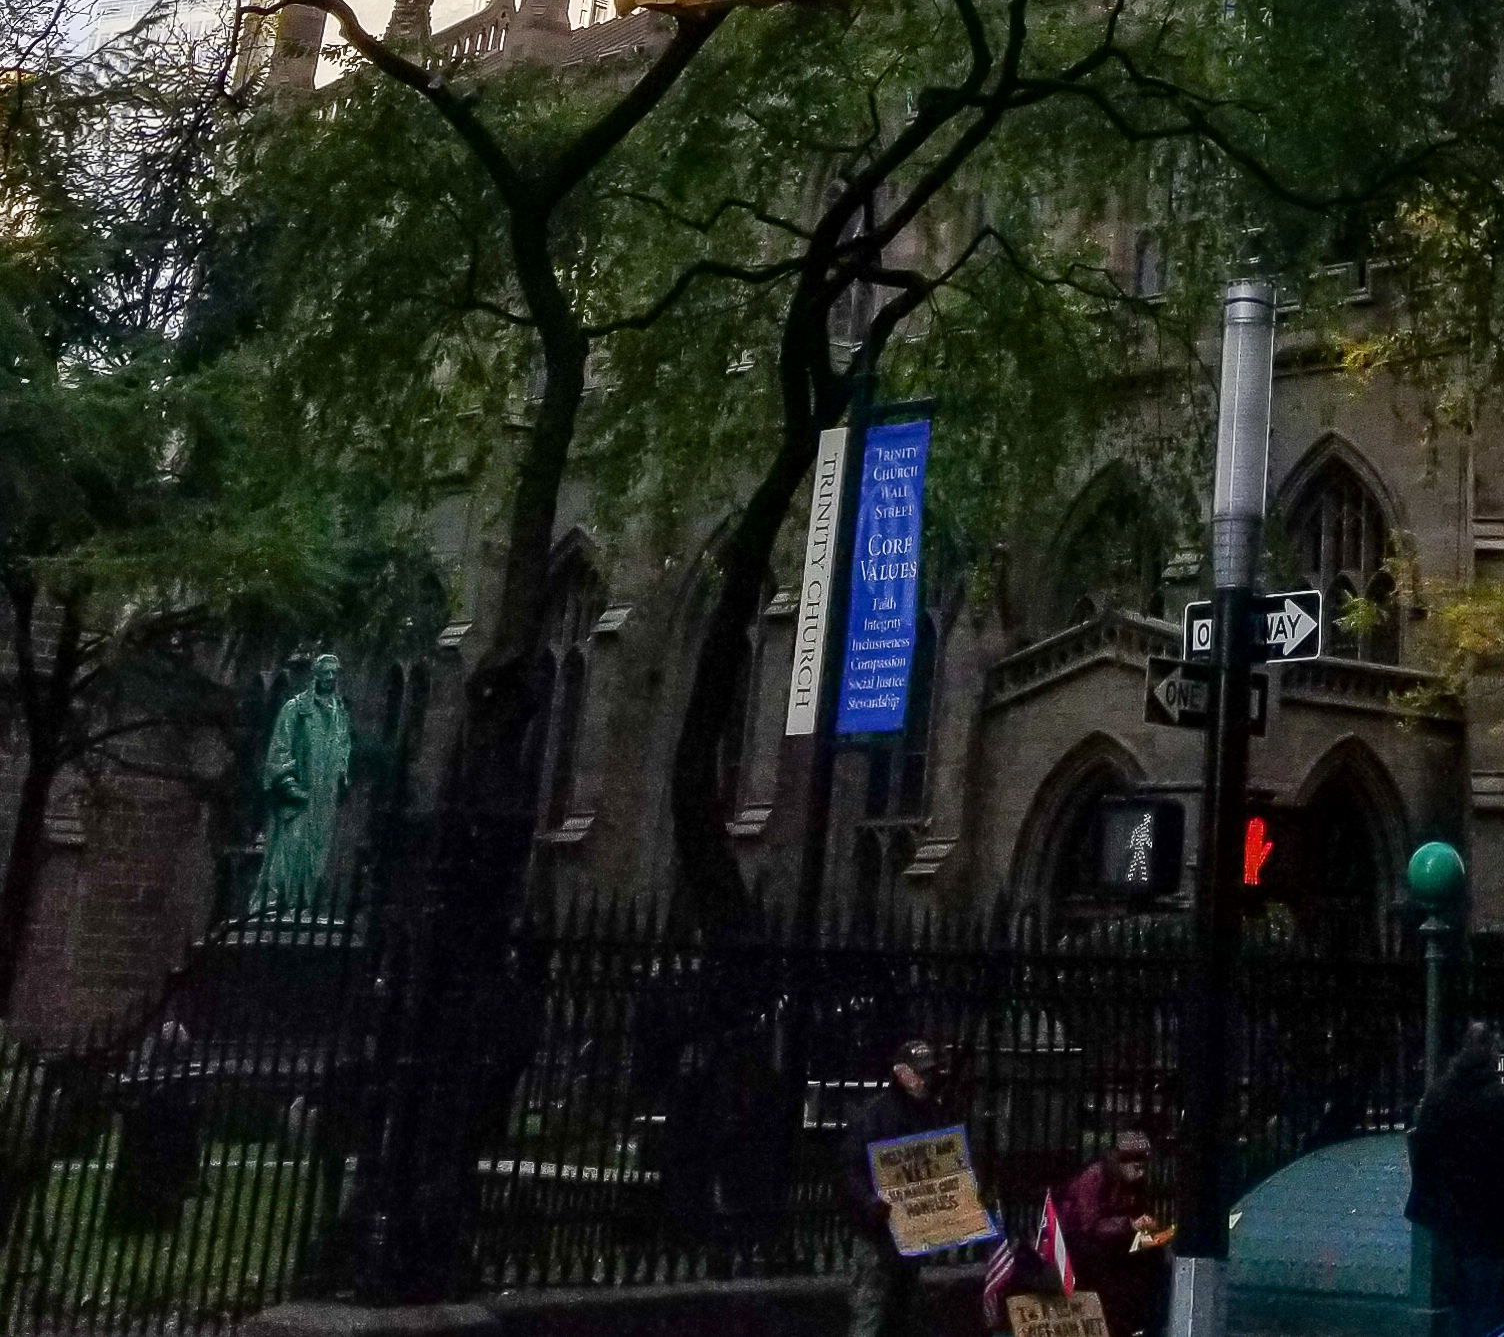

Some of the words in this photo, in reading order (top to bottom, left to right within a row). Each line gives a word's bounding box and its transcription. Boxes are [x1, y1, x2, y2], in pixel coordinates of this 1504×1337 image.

[874, 447, 918, 461] TRINITY
[873, 466, 918, 481] CHURCH
[881, 485, 907, 499] WALL
[811, 453, 837, 570] TRINITY
[875, 504, 914, 520] STREET
[868, 534, 913, 556] CORE
[860, 560, 917, 581] VALUES
[873, 597, 897, 612] Faith
[864, 617, 901, 632] Integrity
[795, 580, 822, 708] CHURCH
[852, 637, 910, 652] Inclusiveness
[850, 656, 906, 673] Compassion
[847, 677, 874, 690] Social
[876, 675, 906, 689] Justice
[847, 693, 900, 711] Stewardship
